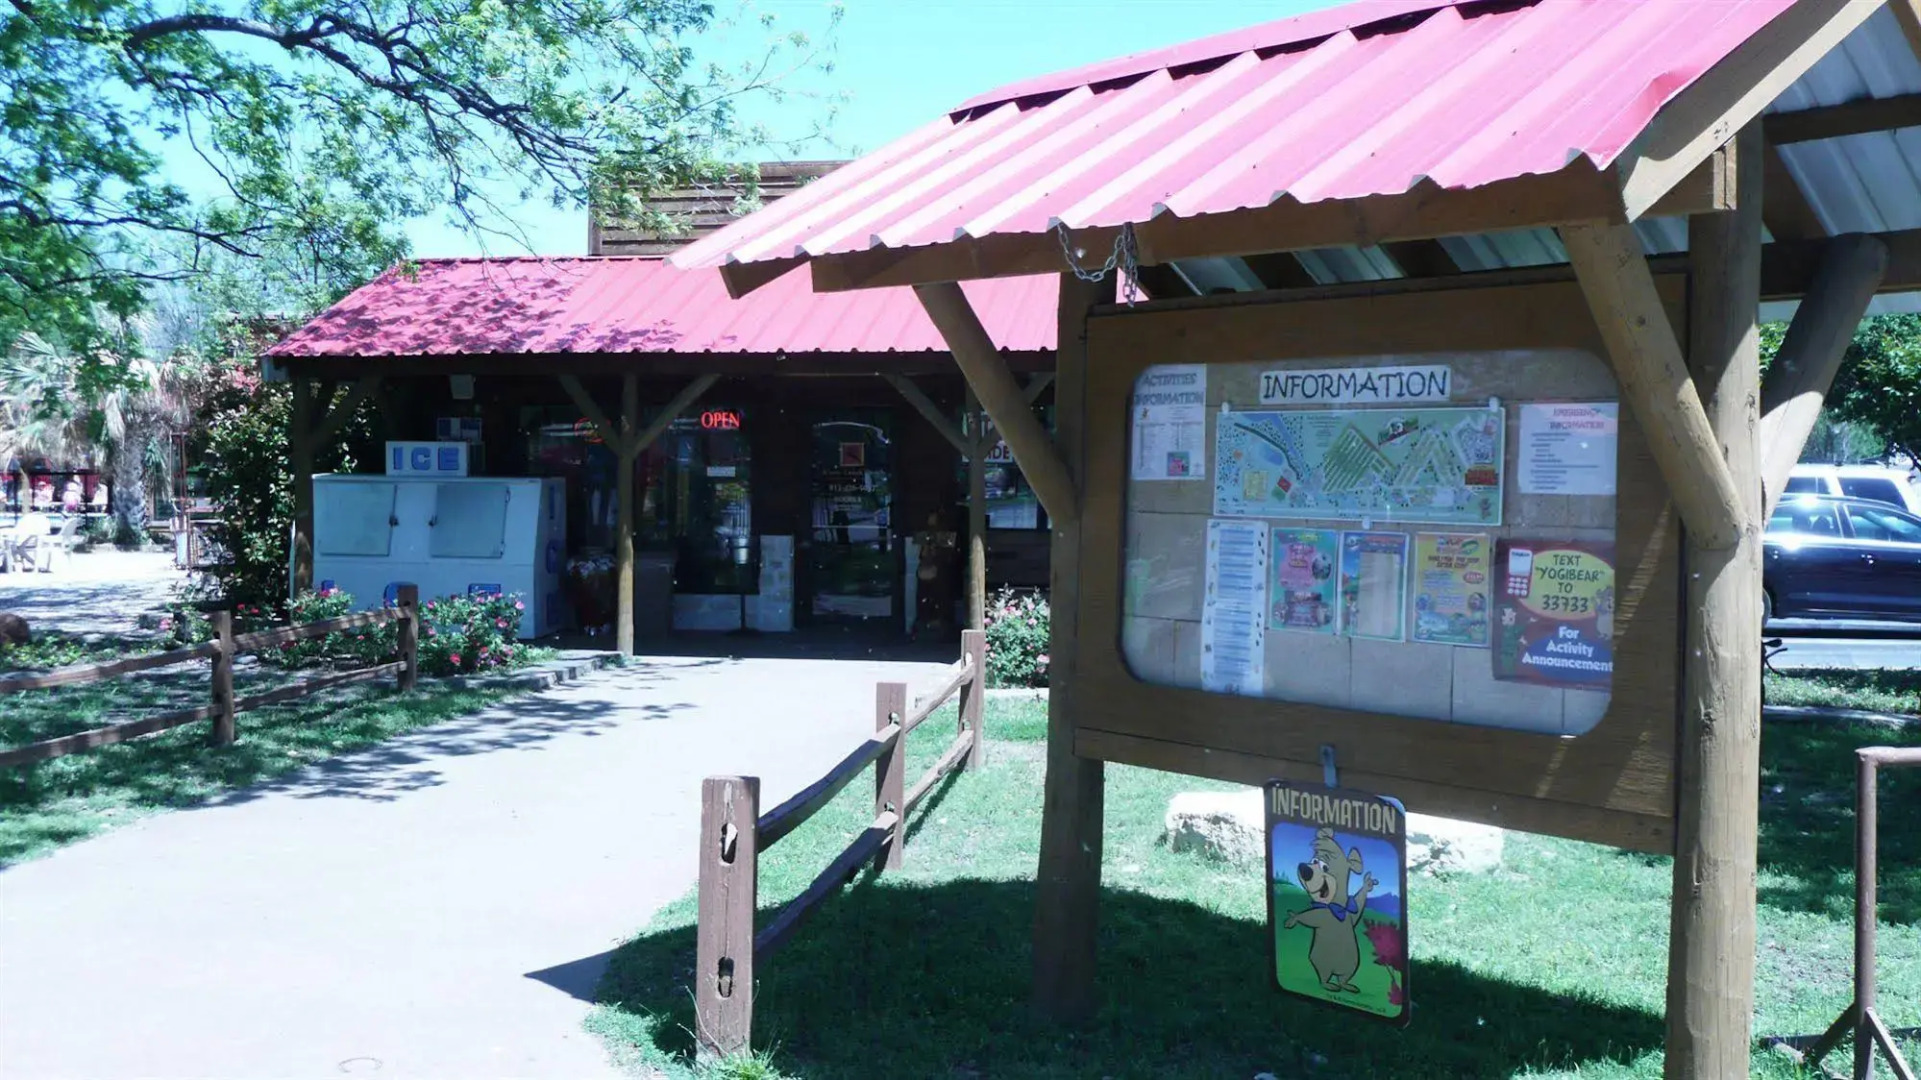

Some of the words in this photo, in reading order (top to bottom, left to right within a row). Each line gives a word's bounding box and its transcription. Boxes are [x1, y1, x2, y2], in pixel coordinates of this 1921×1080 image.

[1263, 370, 1447, 399] INFORMATION
[700, 411, 741, 429] OPEN
[393, 446, 460, 471] ICE
[1553, 554, 1581, 566] TEXT
[1558, 582, 1574, 594] TO
[1541, 594, 1589, 613] 33733
[1558, 626, 1580, 640] For
[1545, 639, 1595, 658] Activity
[1521, 651, 1614, 673] Announcement
[1271, 785, 1397, 835] INFORMATION
